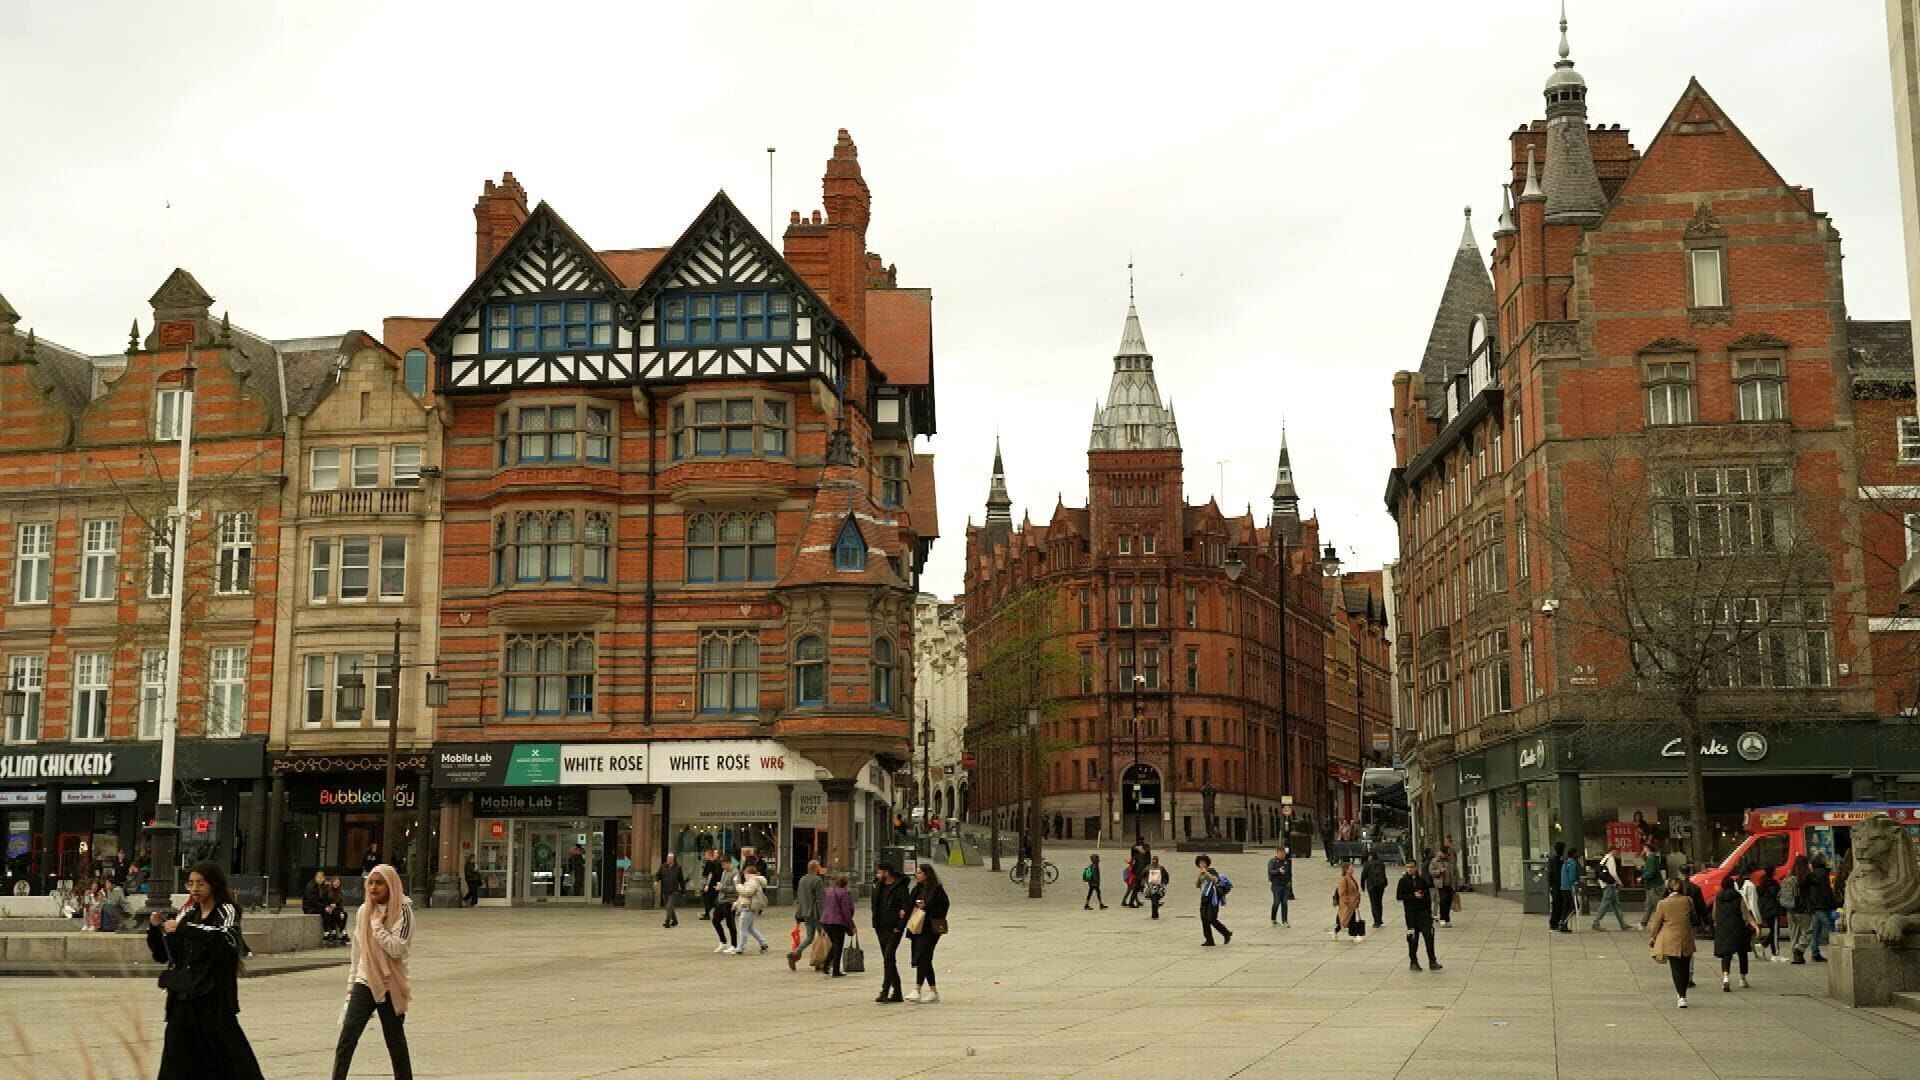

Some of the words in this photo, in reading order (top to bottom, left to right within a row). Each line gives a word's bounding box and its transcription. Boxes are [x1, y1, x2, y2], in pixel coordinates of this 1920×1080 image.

[1661, 738, 1729, 757] Crks
[0, 755, 38, 779] SLIM
[40, 752, 113, 776] CHICKENS
[441, 753, 473, 763] Mobile
[474, 753, 492, 763] Lab
[564, 757, 604, 772] WHITE
[610, 756, 643, 771] ROSE
[670, 755, 710, 771] WHITE
[717, 755, 750, 771] ROSE
[320, 788, 415, 807] Bubbleolgy
[480, 795, 525, 807] Mobile
[528, 795, 552, 807] Lab
